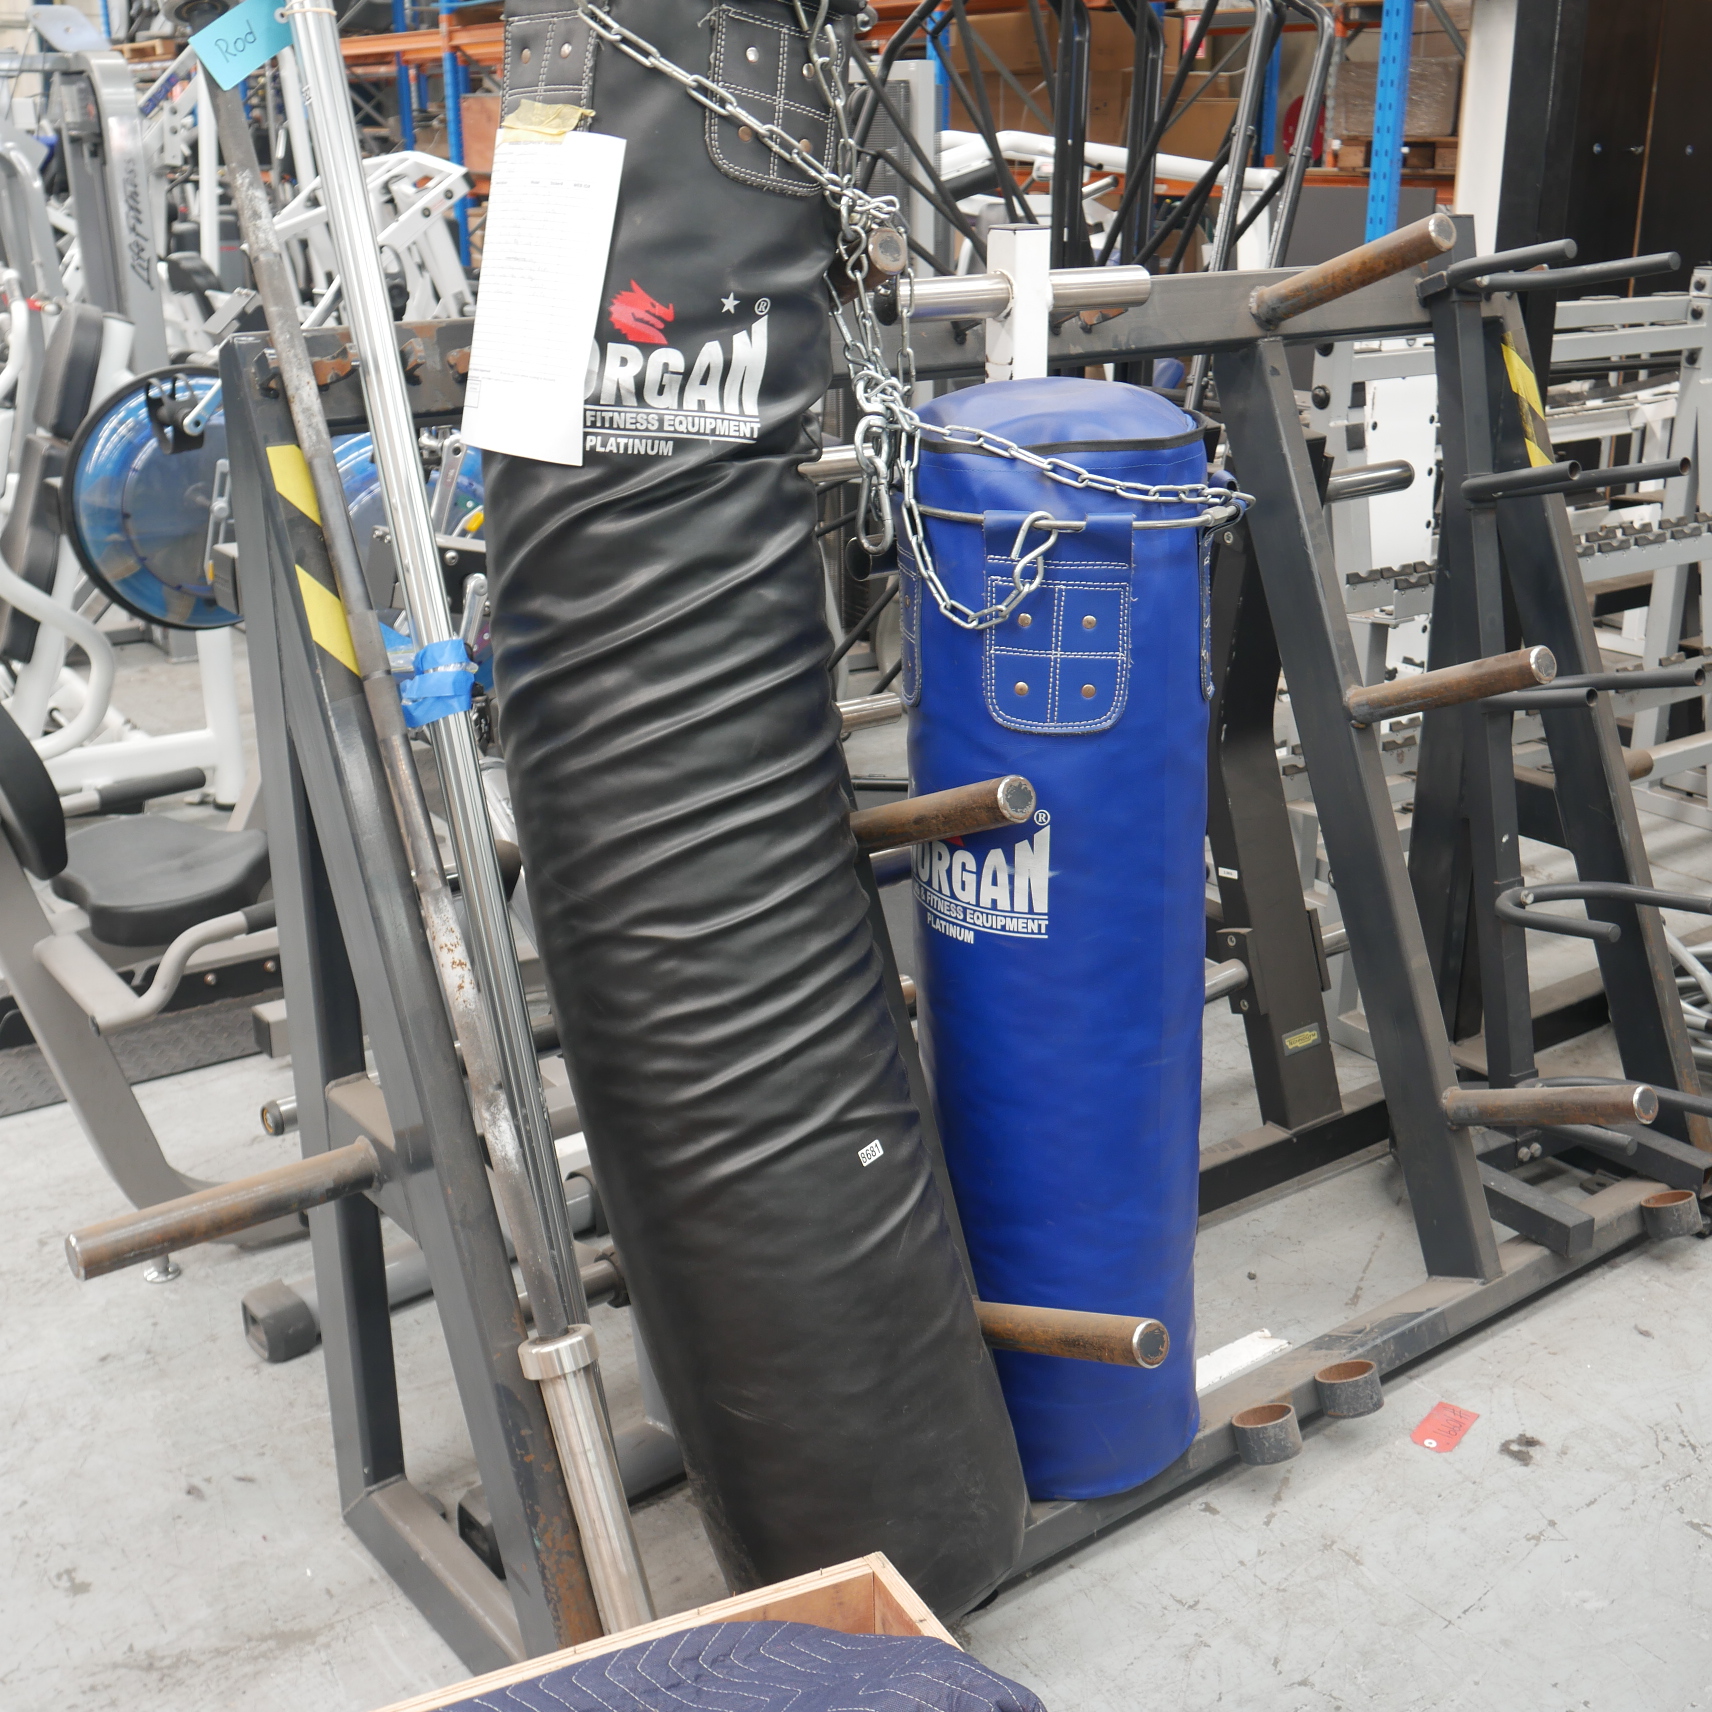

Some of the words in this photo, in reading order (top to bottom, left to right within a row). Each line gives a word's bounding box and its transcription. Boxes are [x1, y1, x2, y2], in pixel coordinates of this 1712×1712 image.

[214, 19, 257, 63] Rod
[584, 314, 769, 416] RGAN
[585, 410, 659, 431] FITNESS
[663, 416, 761, 438] EQUIPMENT
[585, 435, 674, 456] PLATINUM
[911, 825, 1050, 914] ORGAN
[926, 891, 964, 920] FITNESS
[966, 909, 1049, 934] EQUIPMENT
[926, 911, 975, 945] PLATINUM
[860, 1142, 881, 1164] 8681
